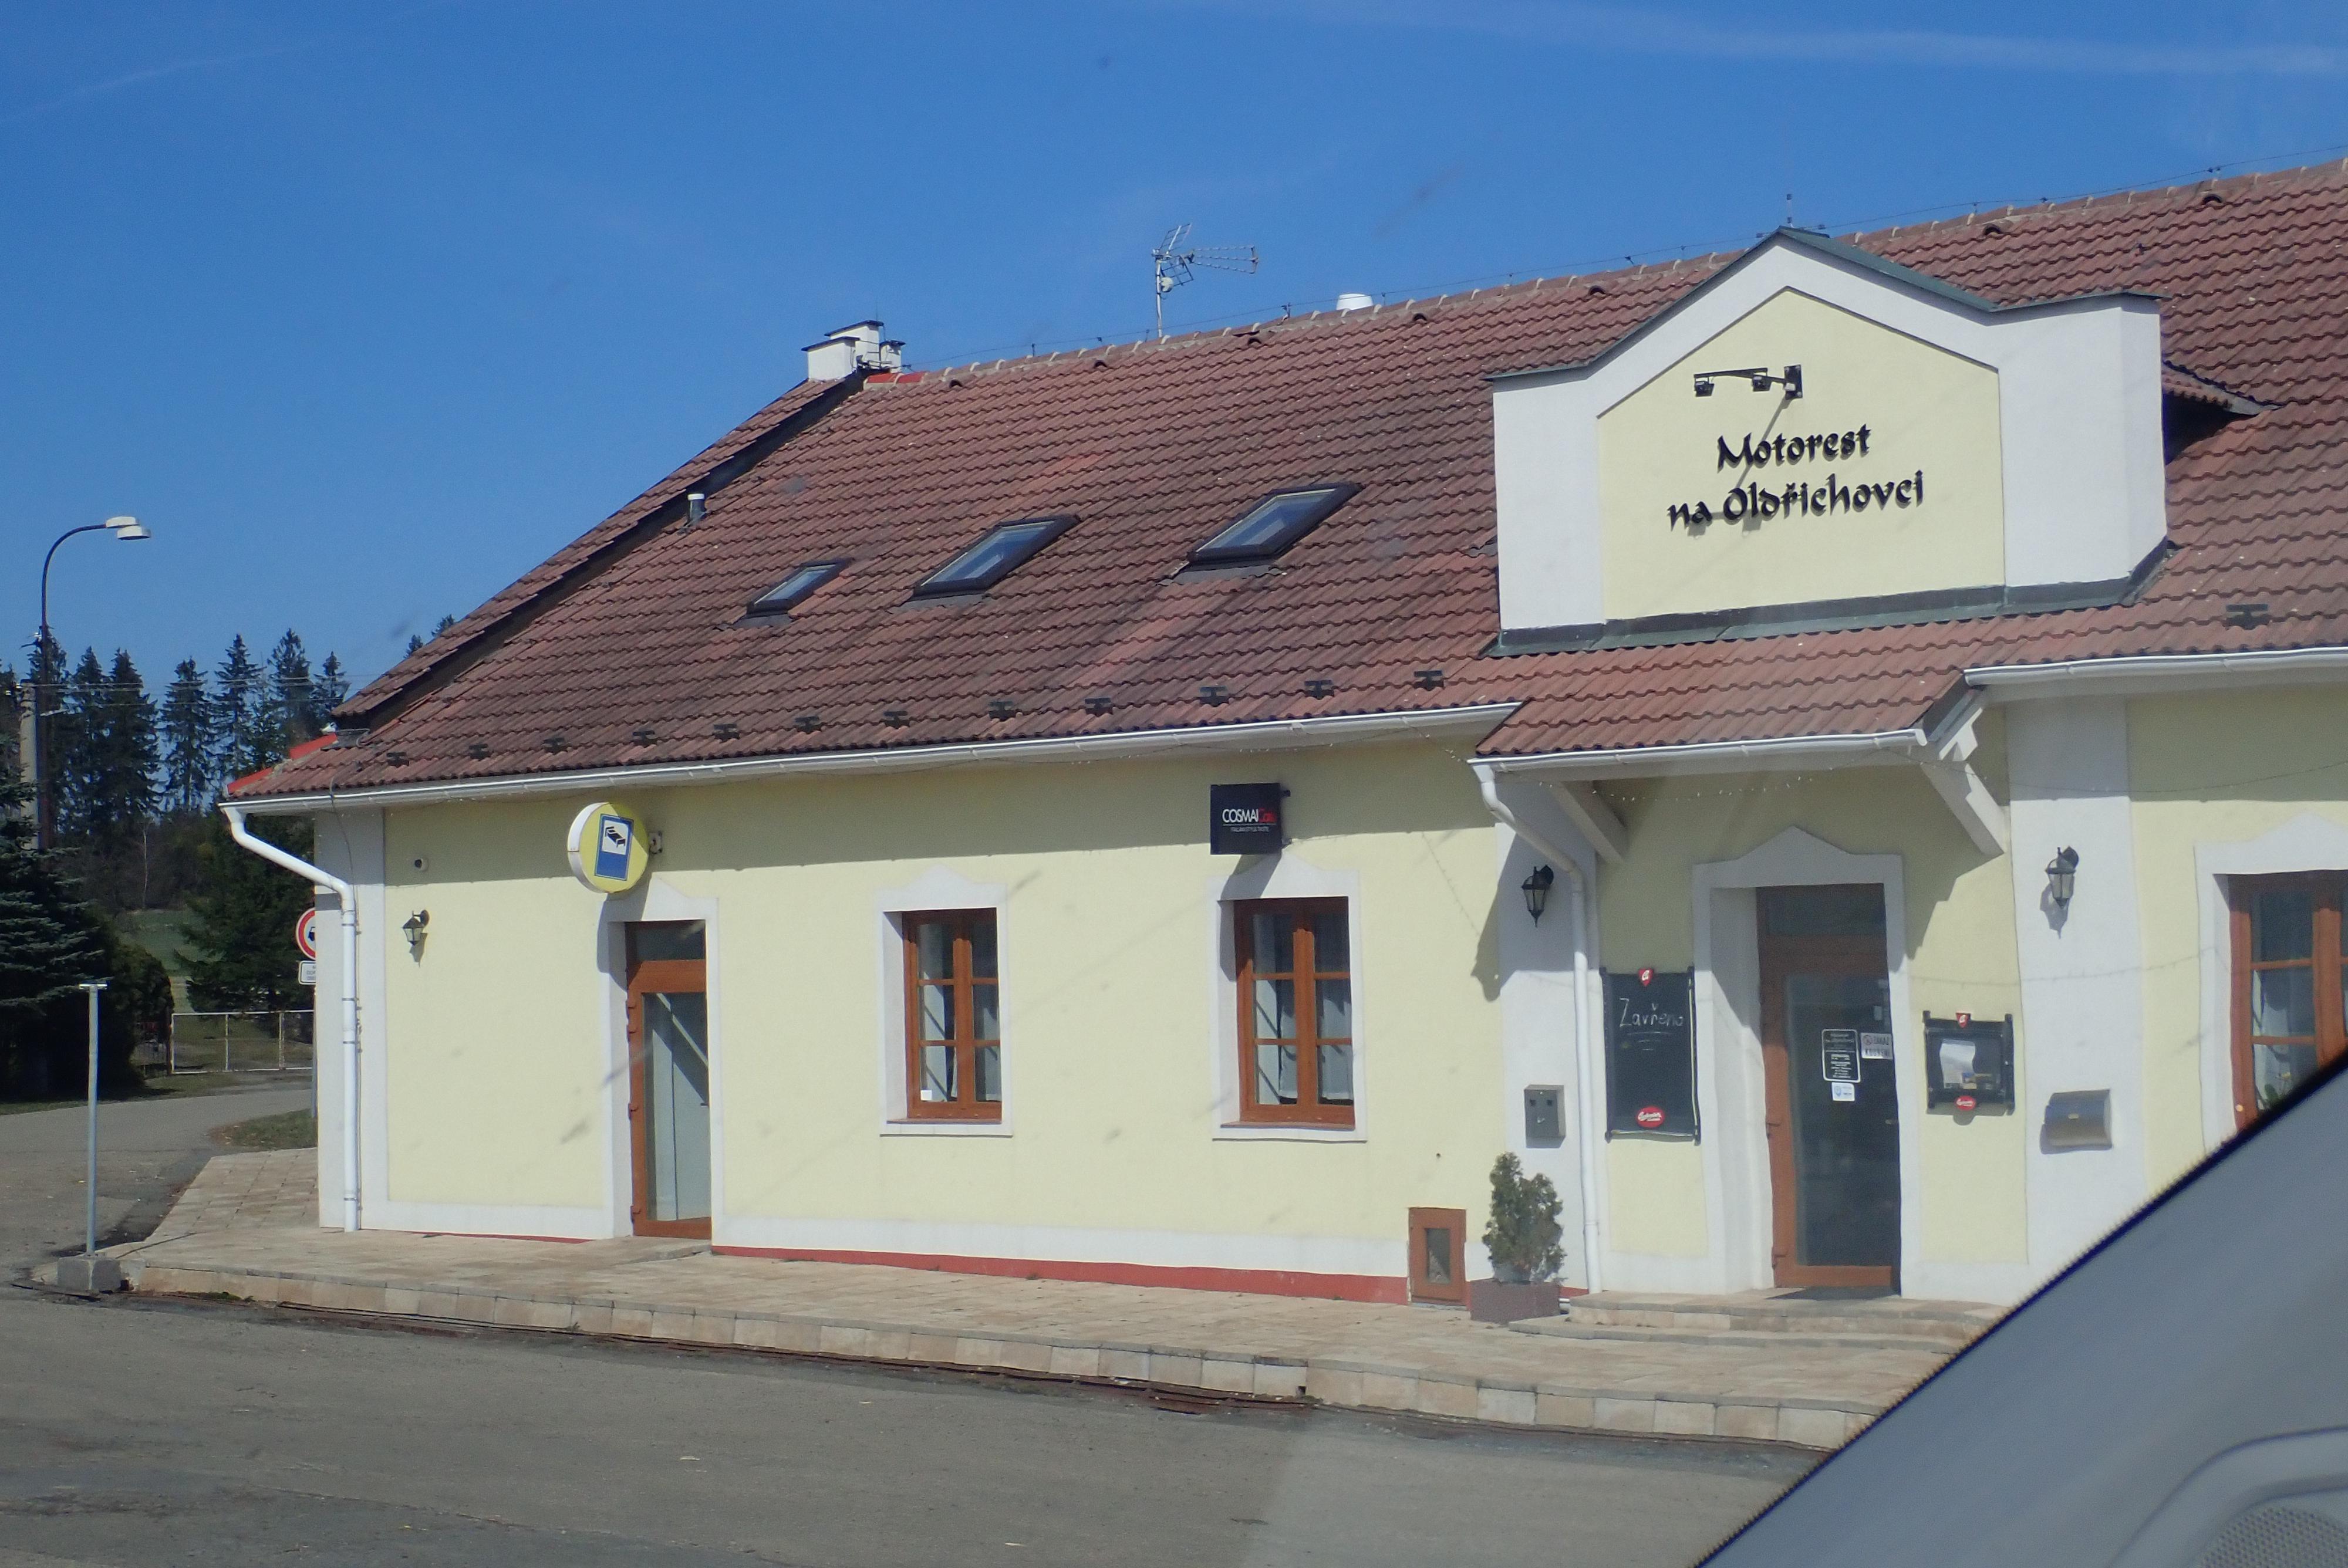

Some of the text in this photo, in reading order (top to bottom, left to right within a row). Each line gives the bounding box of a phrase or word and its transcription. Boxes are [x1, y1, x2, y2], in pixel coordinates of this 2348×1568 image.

[1717, 424, 1871, 472] Motorest
[1667, 469, 1924, 530] na Oldřichovci
